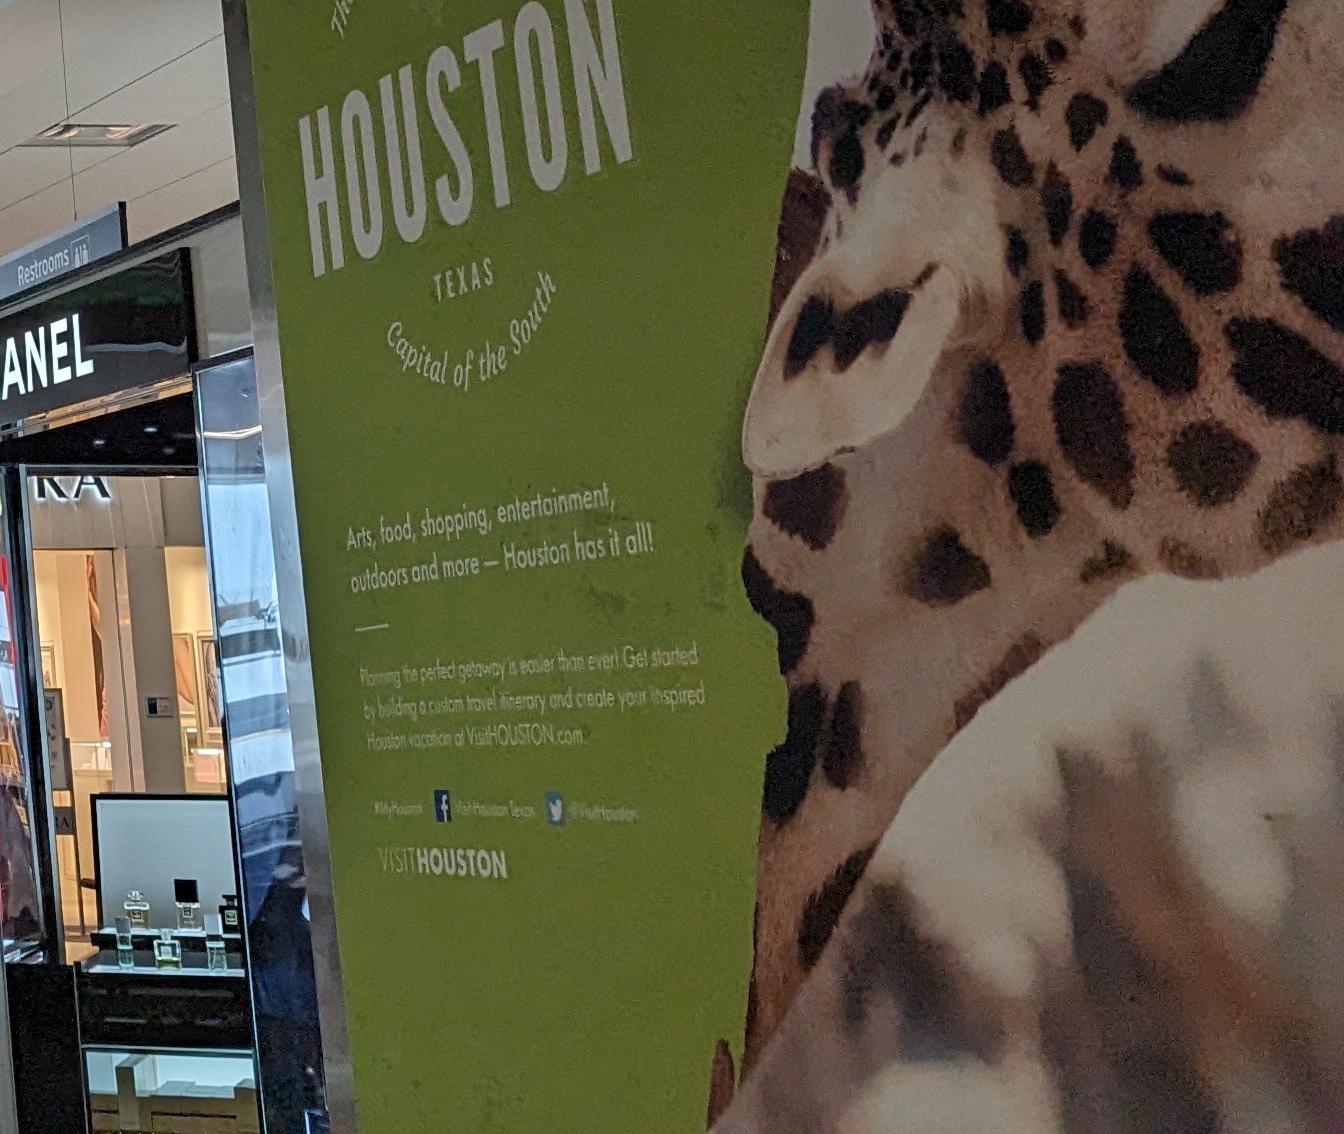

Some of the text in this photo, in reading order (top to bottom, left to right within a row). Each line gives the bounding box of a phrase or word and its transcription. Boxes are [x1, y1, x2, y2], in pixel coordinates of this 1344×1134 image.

[17, 249, 69, 286] Restrooms
[433, 257, 495, 302] TEXAS
[386, 269, 559, 392] Capital of the South
[347, 482, 615, 552] Arts, food, shopping, entertainment,
[351, 563, 409, 593] outdoors
[412, 553, 439, 583] and
[442, 555, 480, 578] more
[503, 539, 570, 570] Houston
[574, 531, 604, 560] has
[609, 528, 621, 556] it
[625, 521, 654, 554] all!
[458, 660, 505, 686] getaway
[623, 644, 649, 668] Get
[651, 641, 698, 667] started
[428, 697, 464, 714] custom
[466, 687, 497, 713] travel
[549, 686, 573, 709] and
[617, 690, 647, 713] your
[650, 680, 705, 712] inspired
